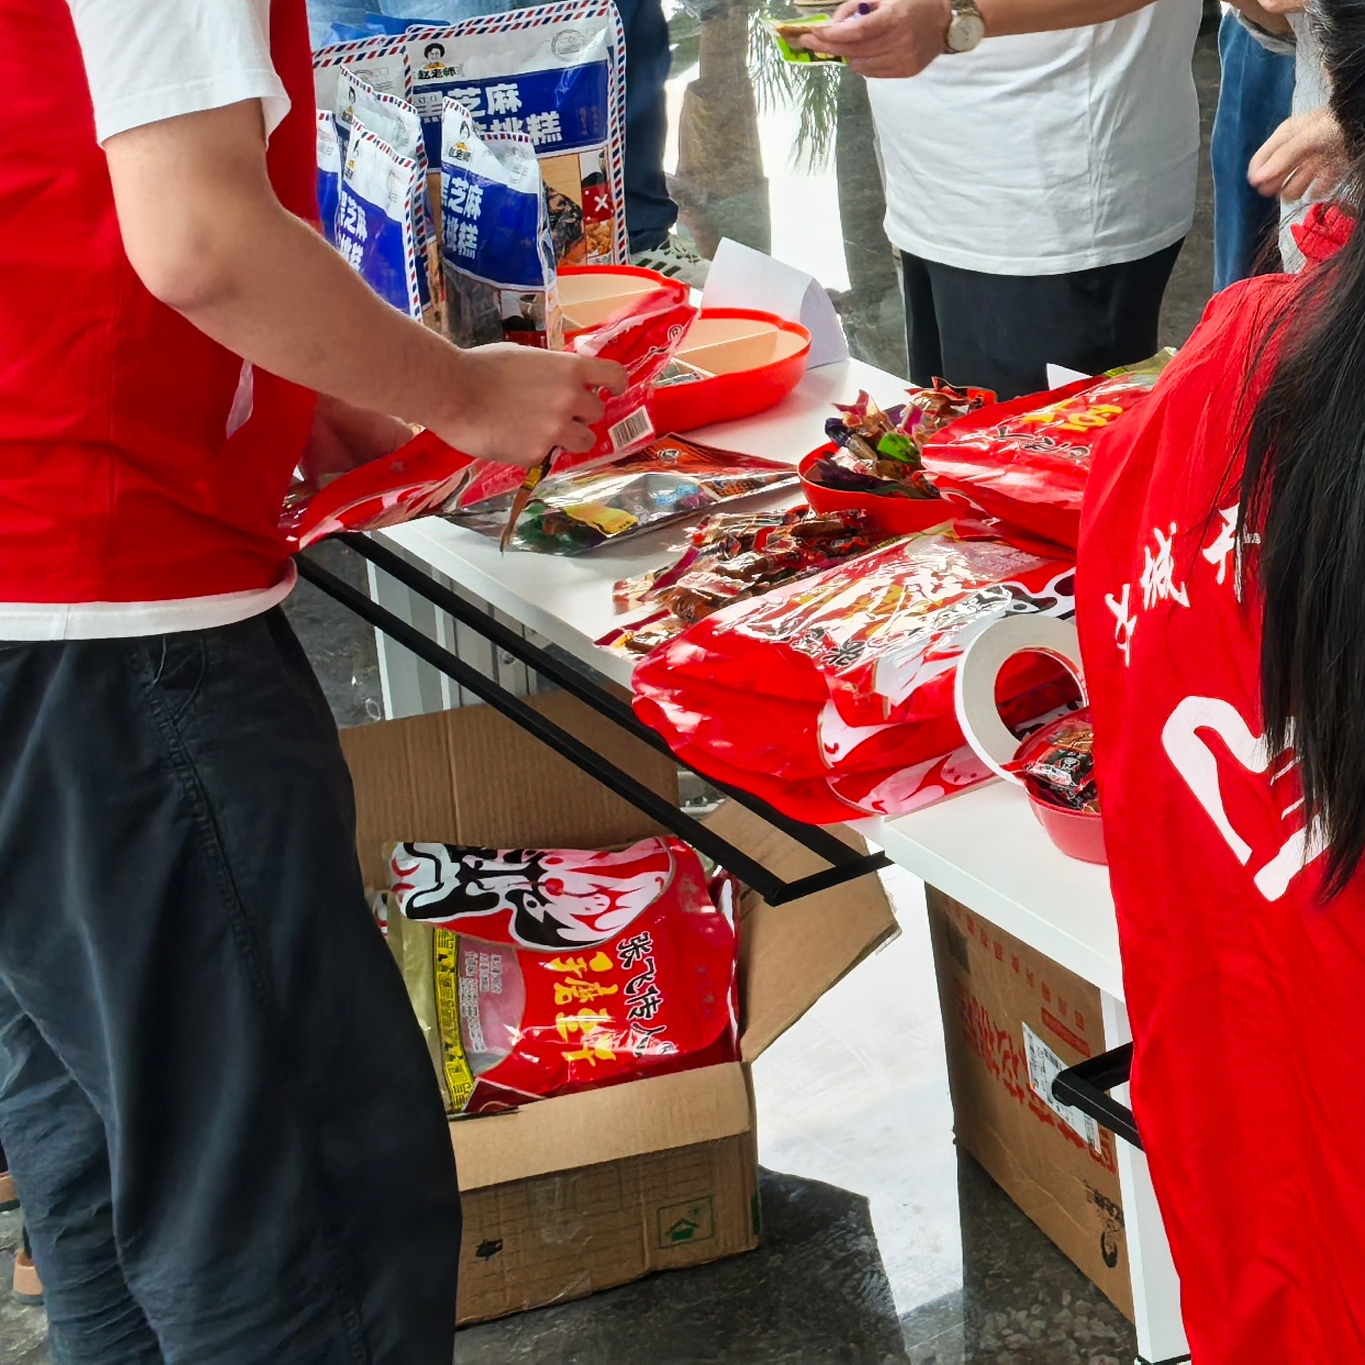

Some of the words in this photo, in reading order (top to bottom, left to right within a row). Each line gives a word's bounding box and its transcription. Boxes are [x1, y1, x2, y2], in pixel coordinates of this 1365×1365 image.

[473, 111, 563, 145] 桃糕
[617, 930, 667, 1058] 张飞传人
